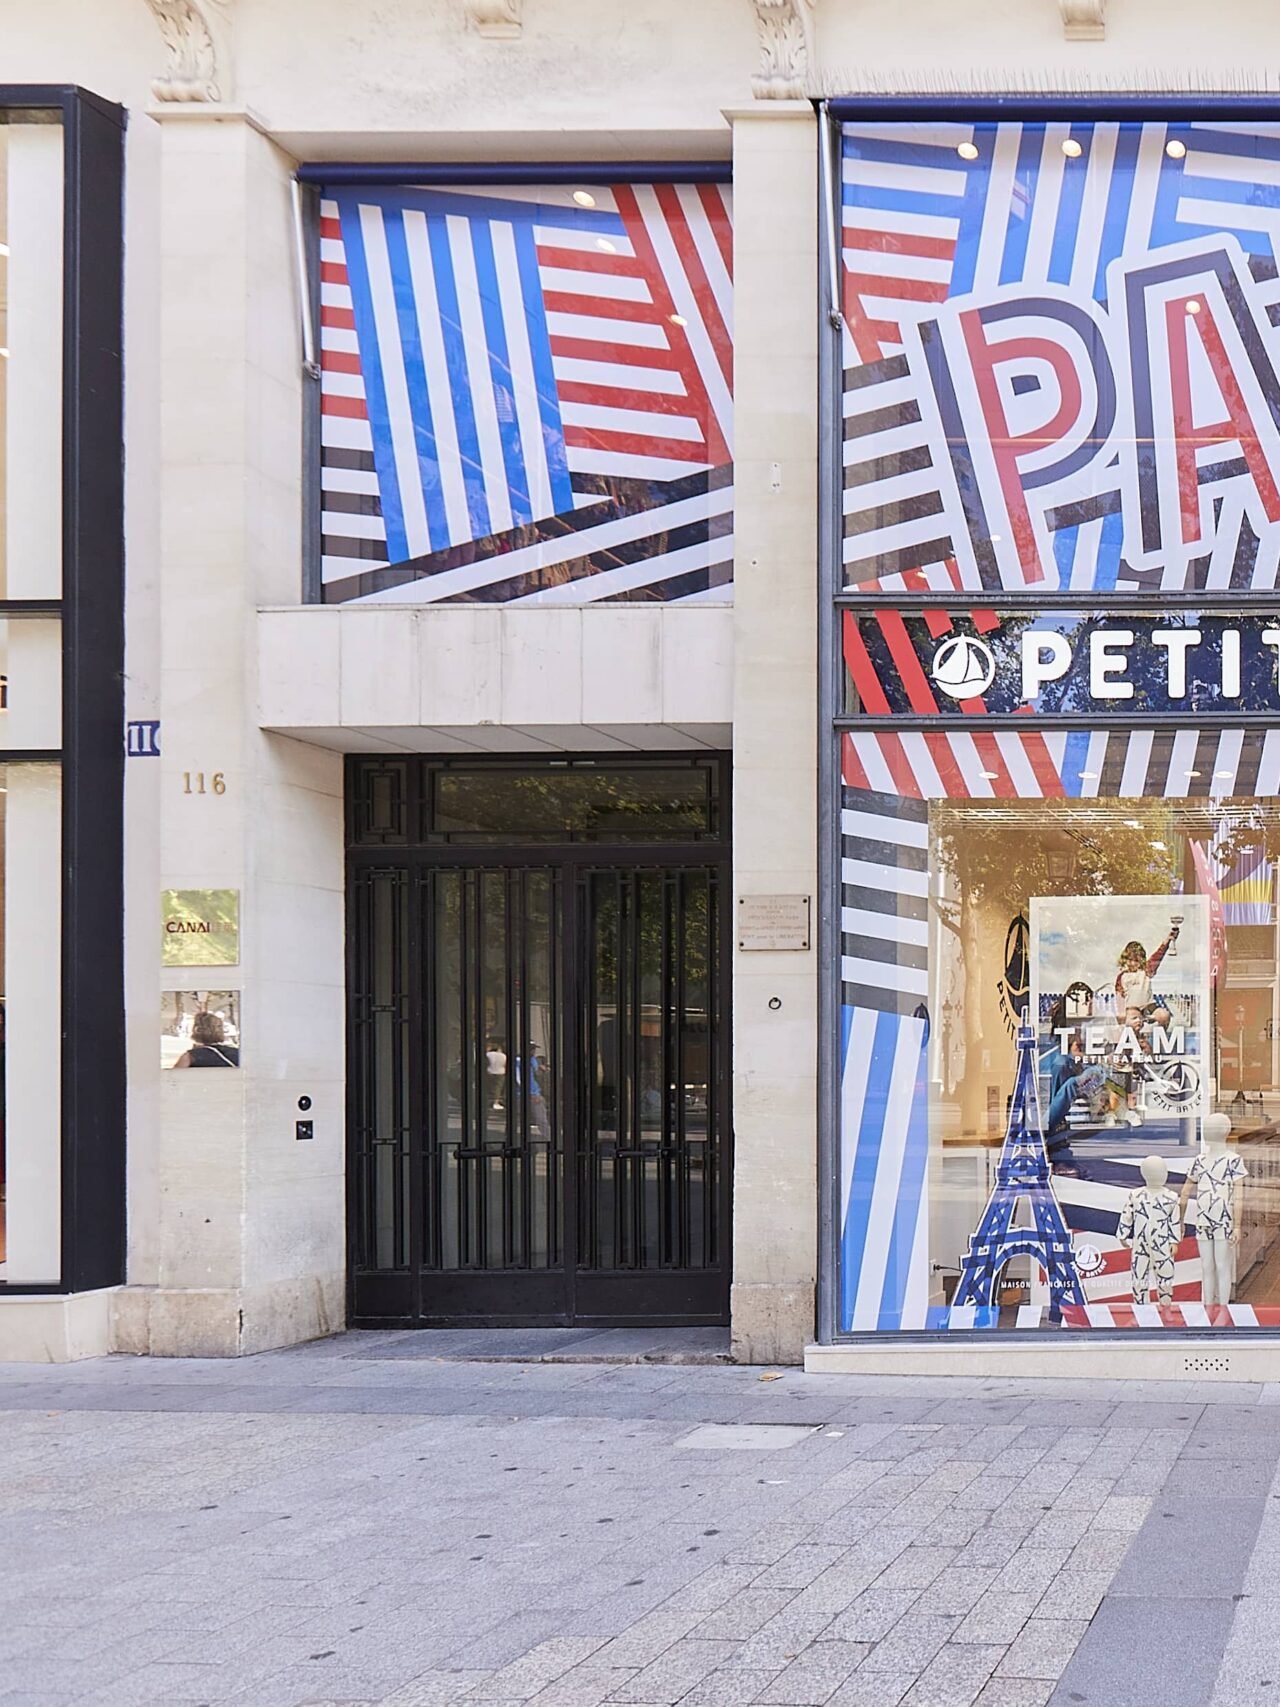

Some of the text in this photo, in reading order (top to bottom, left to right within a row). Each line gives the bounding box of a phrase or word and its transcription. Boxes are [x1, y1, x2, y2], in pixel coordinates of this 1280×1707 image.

[183, 771, 227, 796] 116
[997, 980, 1017, 1041] PETIT
[1054, 1026, 1186, 1056] TEAM
[1074, 1054, 1163, 1064] PETIT BATEAU
